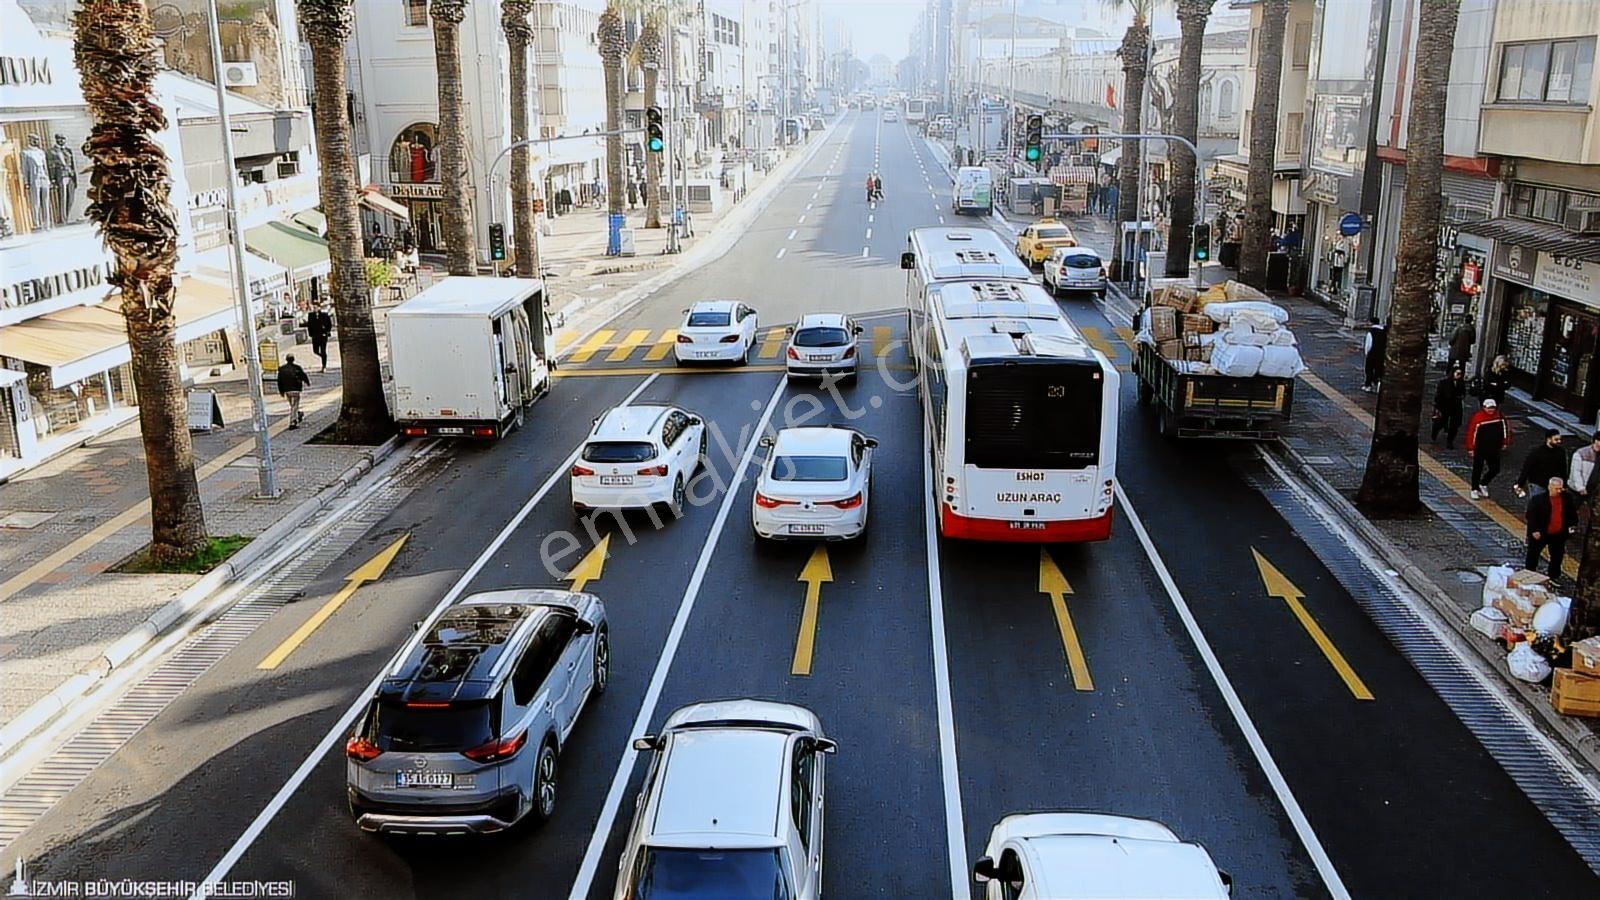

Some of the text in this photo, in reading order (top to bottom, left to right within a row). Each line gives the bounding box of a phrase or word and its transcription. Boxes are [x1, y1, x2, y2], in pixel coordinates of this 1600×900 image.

[1016, 471, 1045, 481] ESHOT
[997, 492, 1062, 504] UZUN ARAÇ
